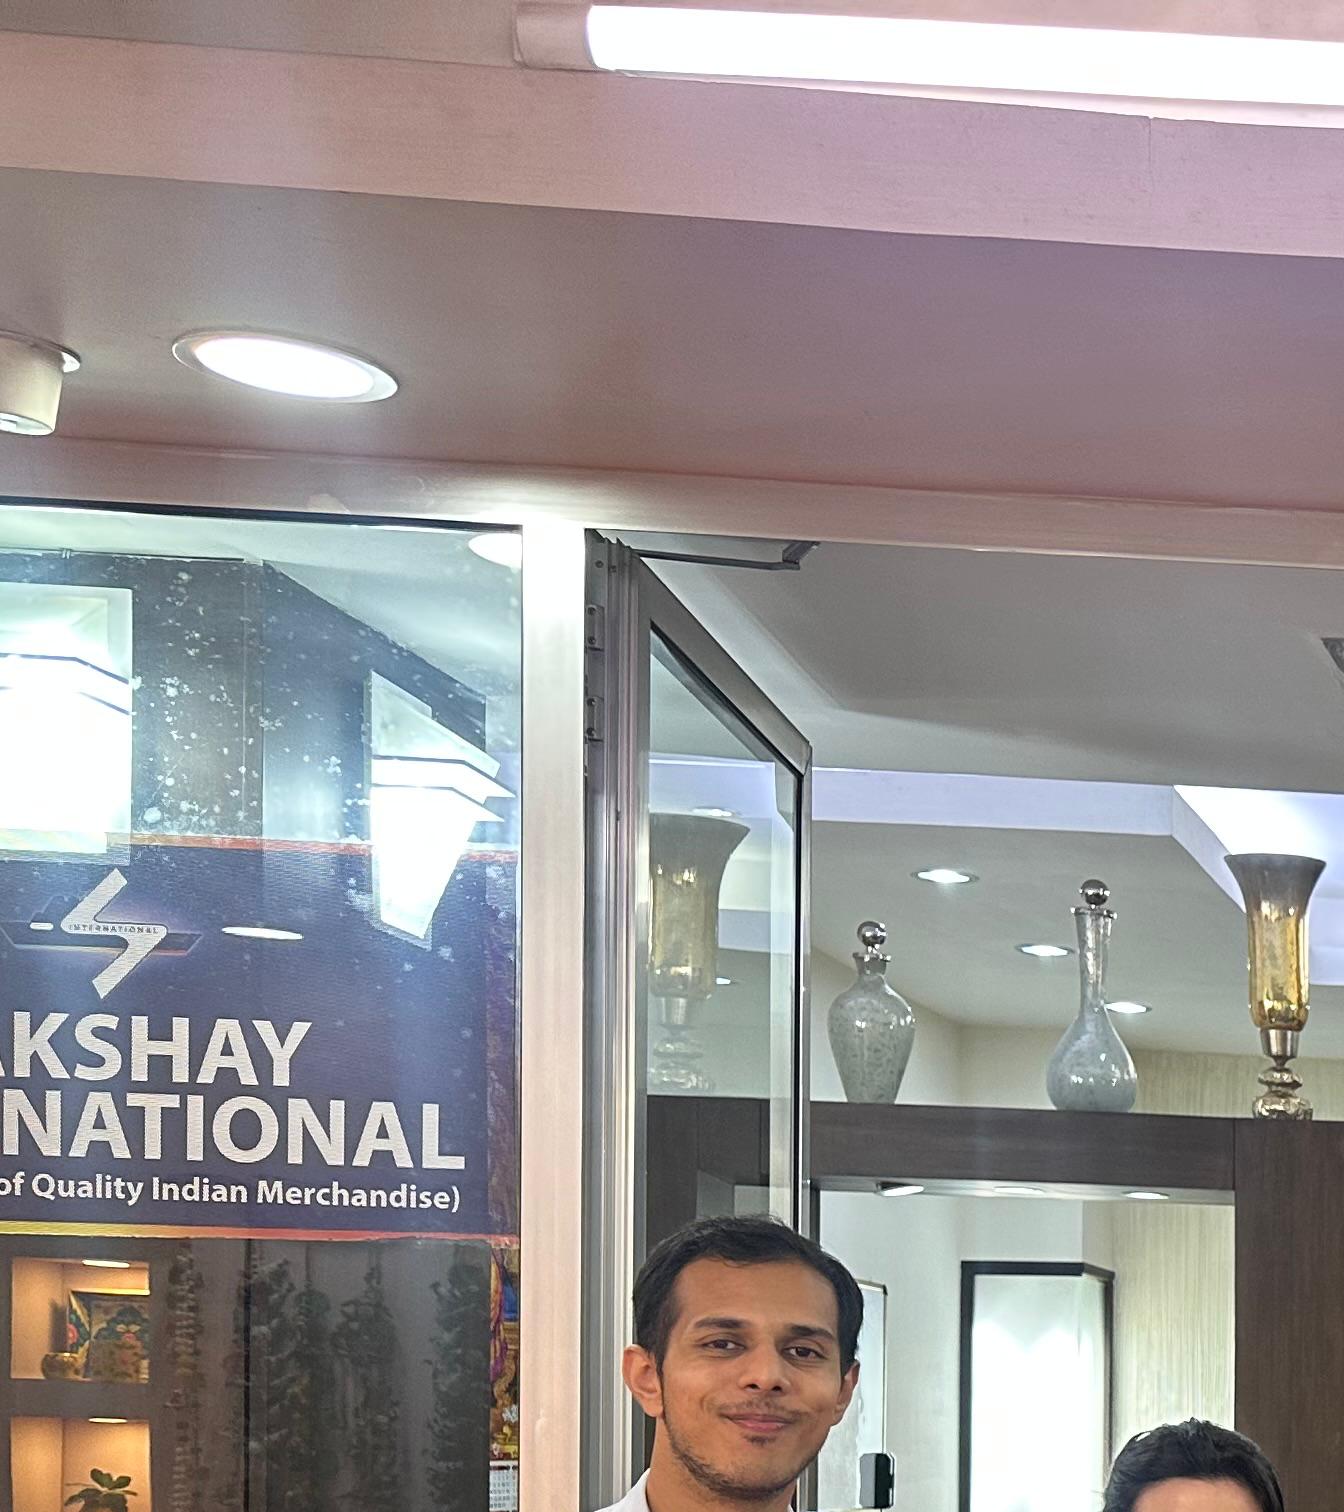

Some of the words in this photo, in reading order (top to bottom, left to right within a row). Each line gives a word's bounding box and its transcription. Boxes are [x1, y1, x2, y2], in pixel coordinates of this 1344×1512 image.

[0, 1010, 312, 1088] KSHAY
[2, 1087, 466, 1171] NATIONAL
[0, 1170, 25, 1196] of
[31, 1173, 145, 1207] Quality
[152, 1176, 248, 1204] Indian
[256, 1180, 461, 1213] Merchandise)
